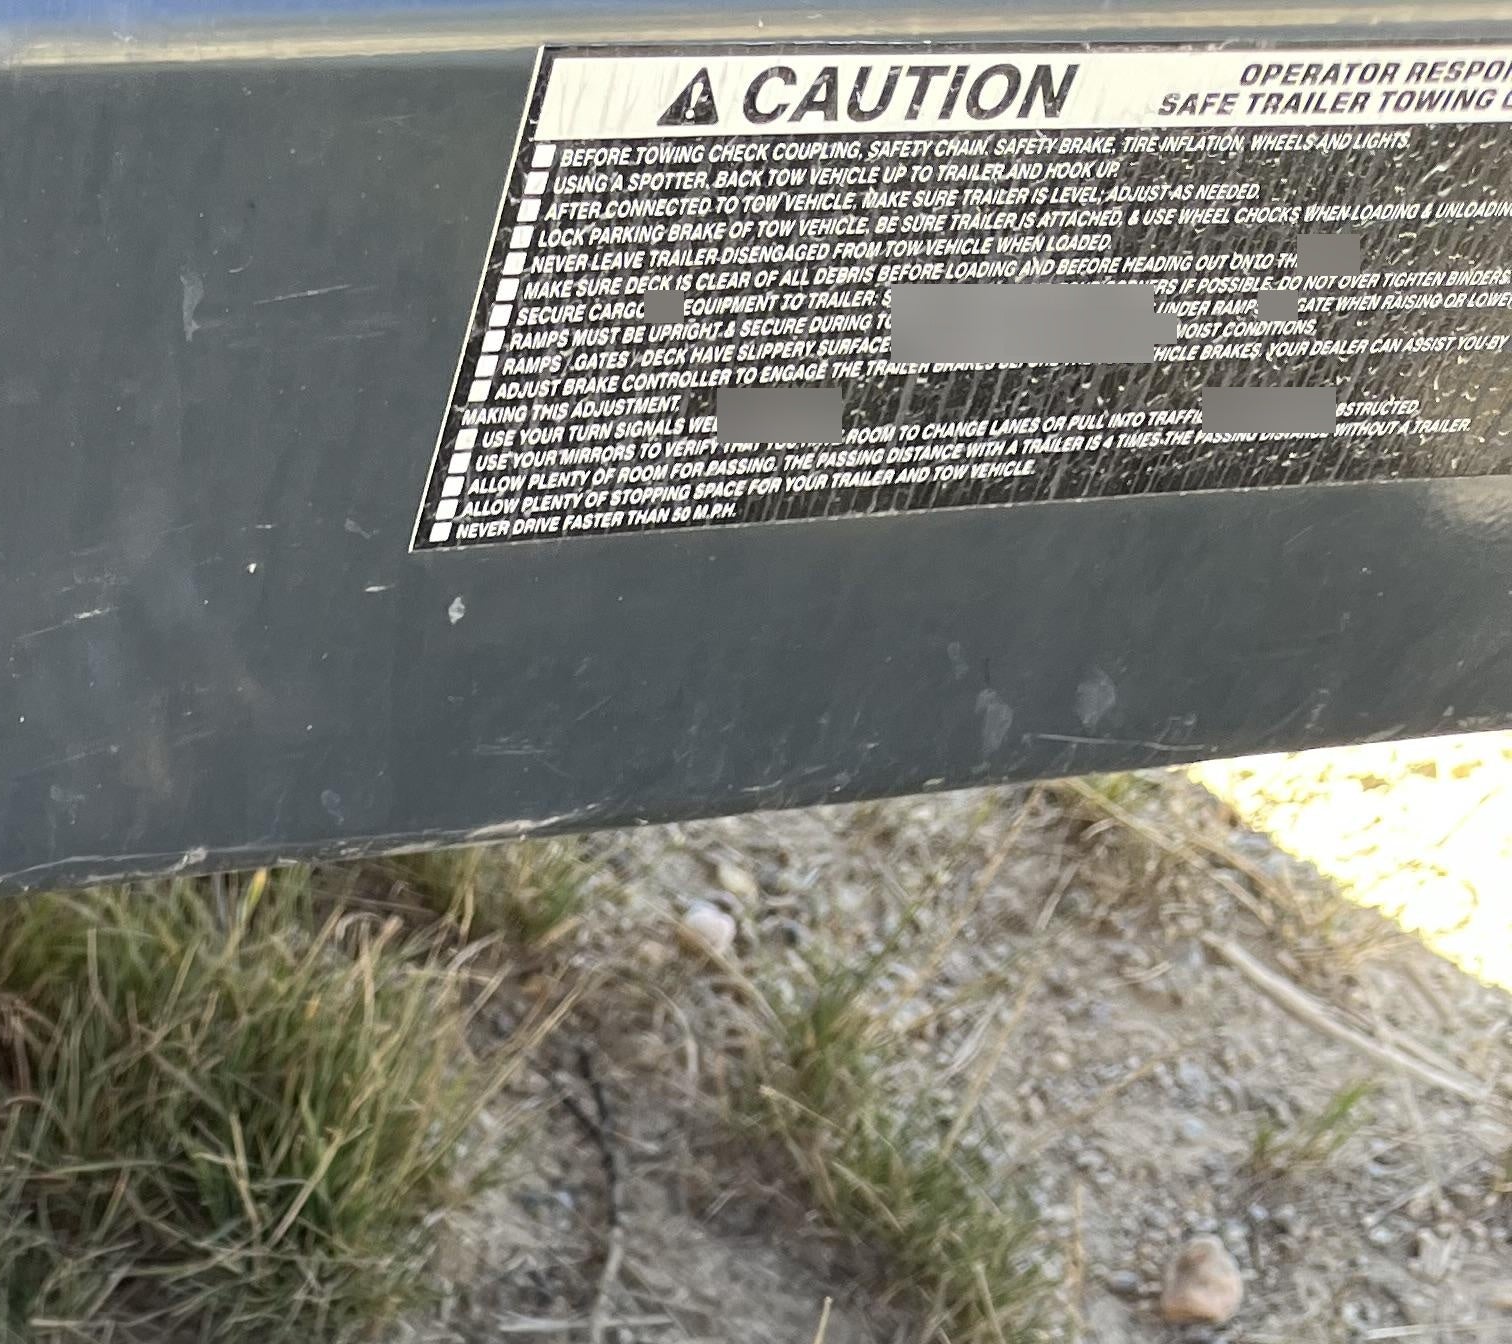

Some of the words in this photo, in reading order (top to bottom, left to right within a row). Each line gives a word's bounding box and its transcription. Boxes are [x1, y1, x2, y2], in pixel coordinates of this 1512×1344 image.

[1240, 62, 1400, 86] OPERATOR
[743, 64, 1079, 124] CAUTION
[1158, 92, 1238, 116] SAFE
[1247, 92, 1370, 114] TRAILER
[1379, 90, 1496, 112] TOWING
[559, 148, 632, 166] BEFORE
[635, 146, 704, 164] TOWING
[708, 144, 770, 162] CHECK
[772, 142, 864, 160] COUPLING,
[868, 140, 932, 158] SAFETY
[994, 138, 1058, 154] SAFETY
[1058, 136, 1118, 154] BRAKE,
[1123, 136, 1160, 152] TIRE
[1251, 134, 1318, 152] WHEELS
[1317, 132, 1352, 150] AND
[552, 174, 608, 194] USING
[611, 174, 624, 192] A
[715, 170, 764, 188] BACK
[767, 168, 806, 186] TOW
[809, 166, 878, 184] VEHICLE
[883, 166, 908, 182] UP
[910, 166, 932, 182] TO
[937, 164, 1004, 182] TRAILER
[1007, 162, 1042, 180] AND
[1045, 162, 1092, 178] HOOK
[1096, 162, 1120, 178] UP.
[531, 254, 588, 272] NEVER
[592, 250, 644, 270] LEAVE
[649, 248, 718, 268] TRAILER
[721, 242, 830, 264] DISENGAGED
[833, 240, 882, 260] FROM
[885, 240, 922, 258] TOW
[925, 236, 992, 256] VEHICLE
[996, 236, 1046, 254] WHEN
[1047, 234, 1112, 252] LOADED.
[461, 404, 528, 426] MAKING
[530, 402, 568, 420] THIS
[463, 498, 518, 516] ALLOW
[522, 492, 580, 512] PLENTY
[584, 490, 608, 508] OF
[610, 484, 690, 506] STOPPING
[694, 480, 744, 500] SPACE
[748, 478, 782, 494] FOR
[784, 474, 828, 492] YOUR
[831, 470, 894, 488] TRAILER
[896, 468, 930, 484] AND
[933, 464, 968, 482] TOW
[970, 460, 1036, 478] VEHICLE.
[456, 520, 510, 540] NEVER
[512, 516, 560, 534] DRIVE
[564, 512, 622, 530] FASTER
[626, 508, 668, 526] THAN
[672, 506, 690, 522] 50
[694, 502, 738, 520] M.P.H.
